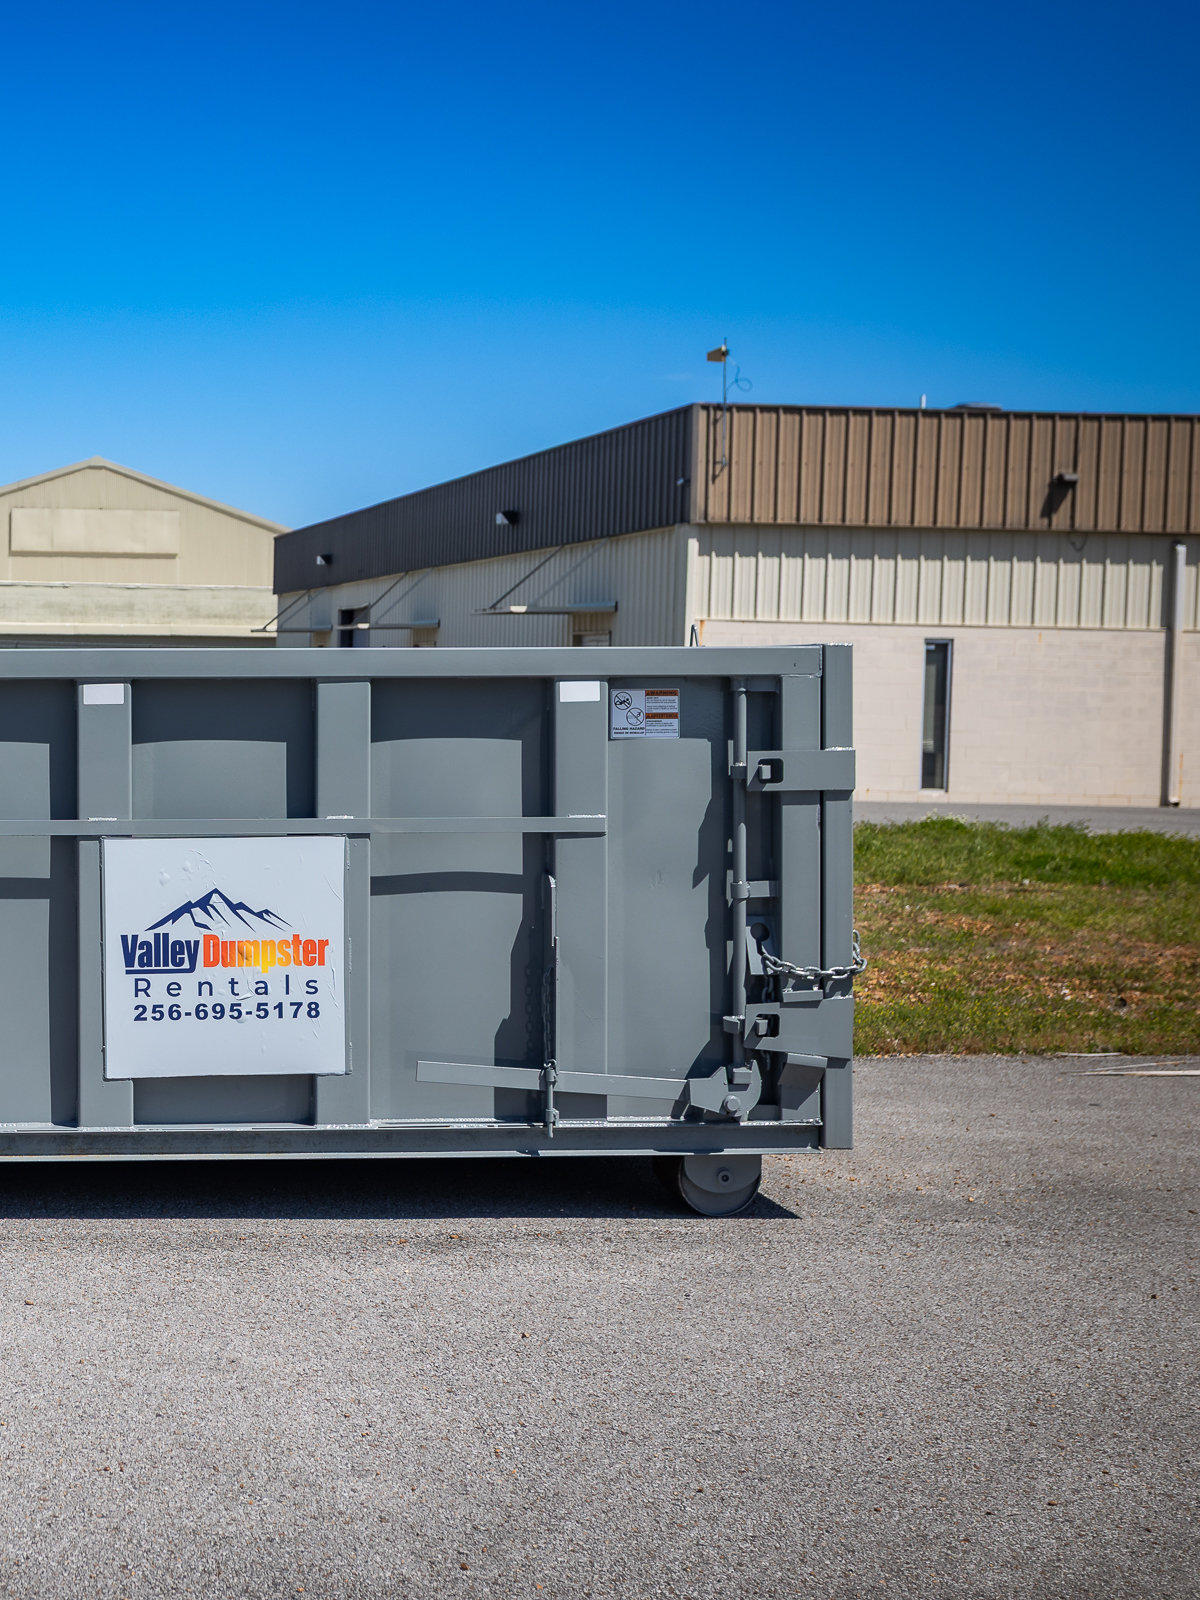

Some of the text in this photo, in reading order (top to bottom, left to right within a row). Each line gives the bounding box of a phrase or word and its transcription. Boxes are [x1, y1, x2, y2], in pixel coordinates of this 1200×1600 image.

[203, 934, 329, 973] Dumpster
[134, 974, 319, 998] Rentals
[133, 1001, 320, 1022] 256-695-5178
